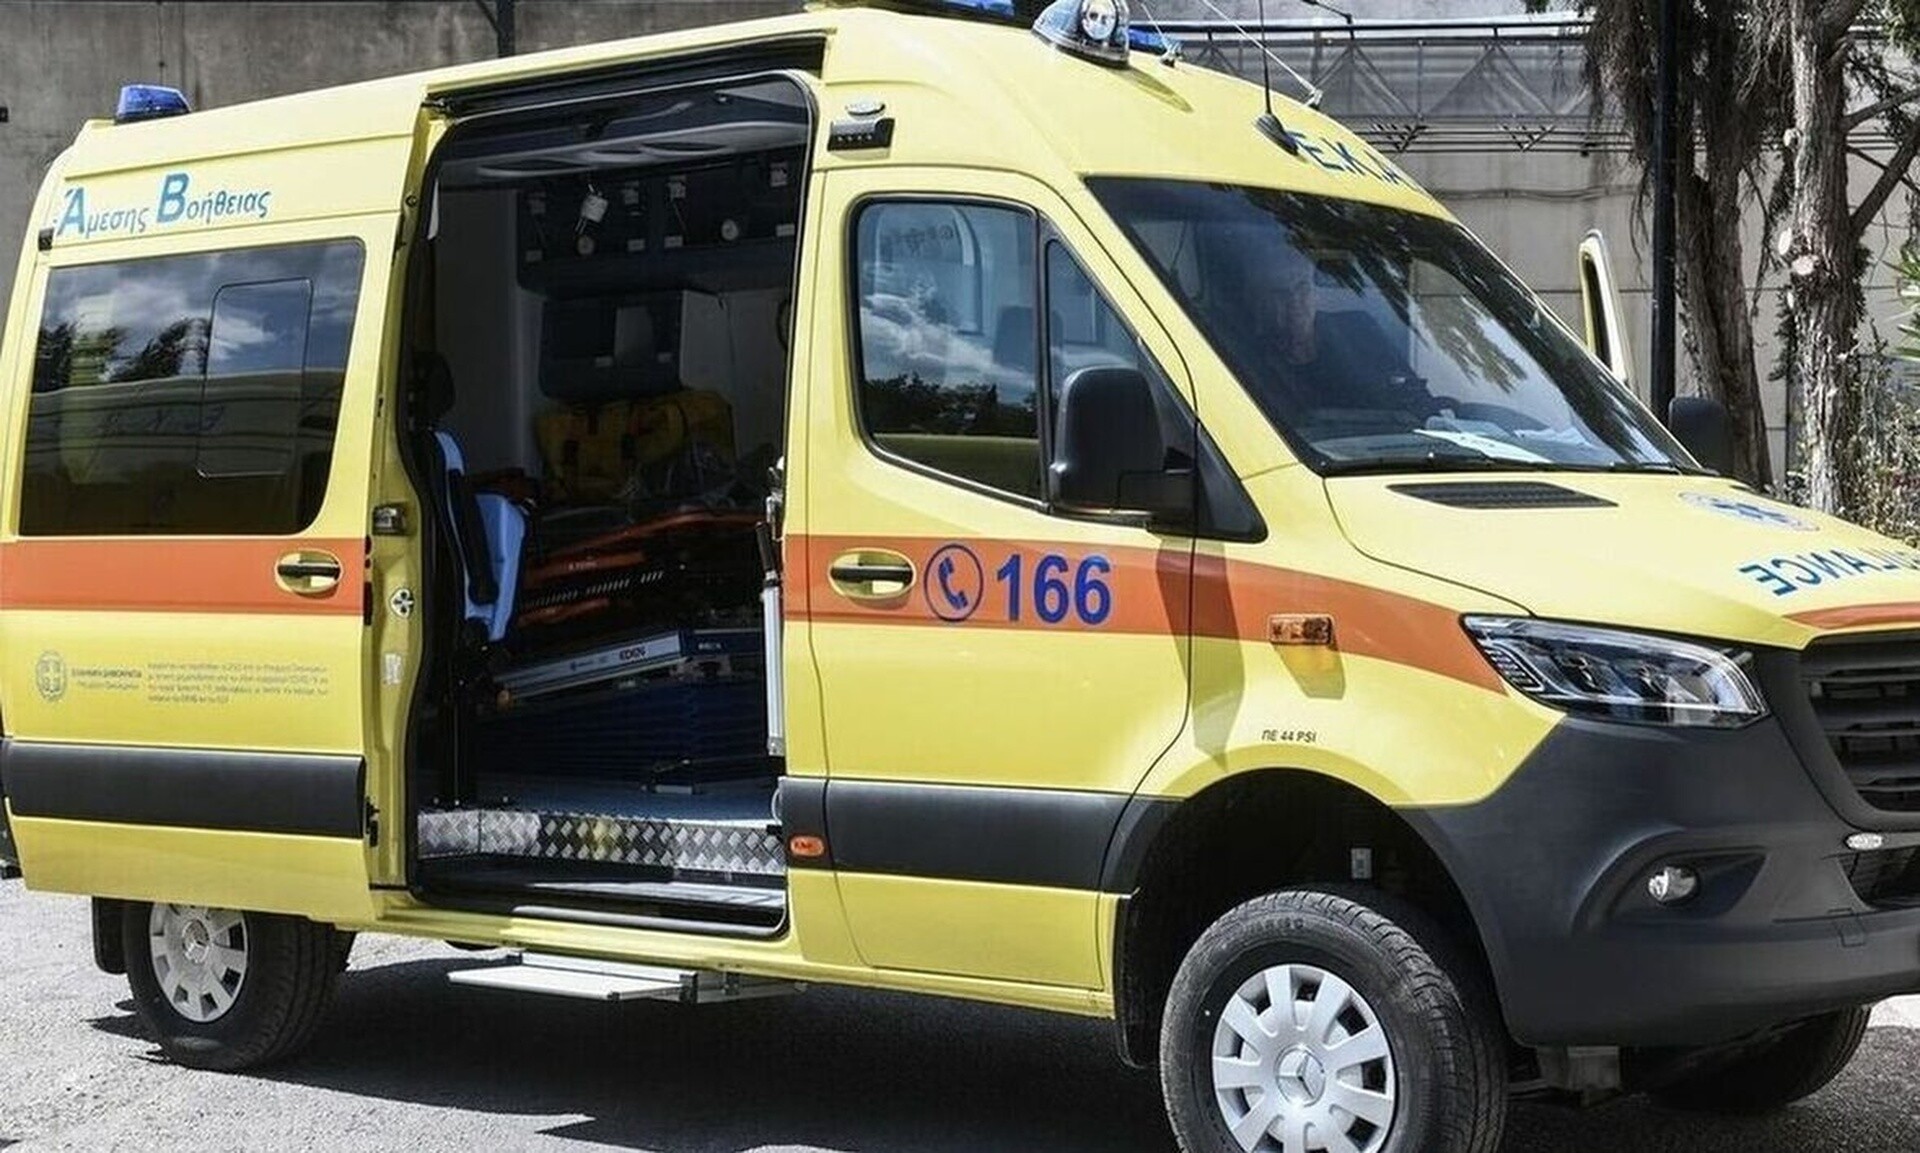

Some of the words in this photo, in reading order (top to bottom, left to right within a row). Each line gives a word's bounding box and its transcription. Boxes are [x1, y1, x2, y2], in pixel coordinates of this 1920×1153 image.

[57, 186, 149, 239] Άμεσης
[157, 172, 272, 224] Βοήθειας
[996, 553, 1111, 625] 166
[1296, 730, 1317, 744] PSI
